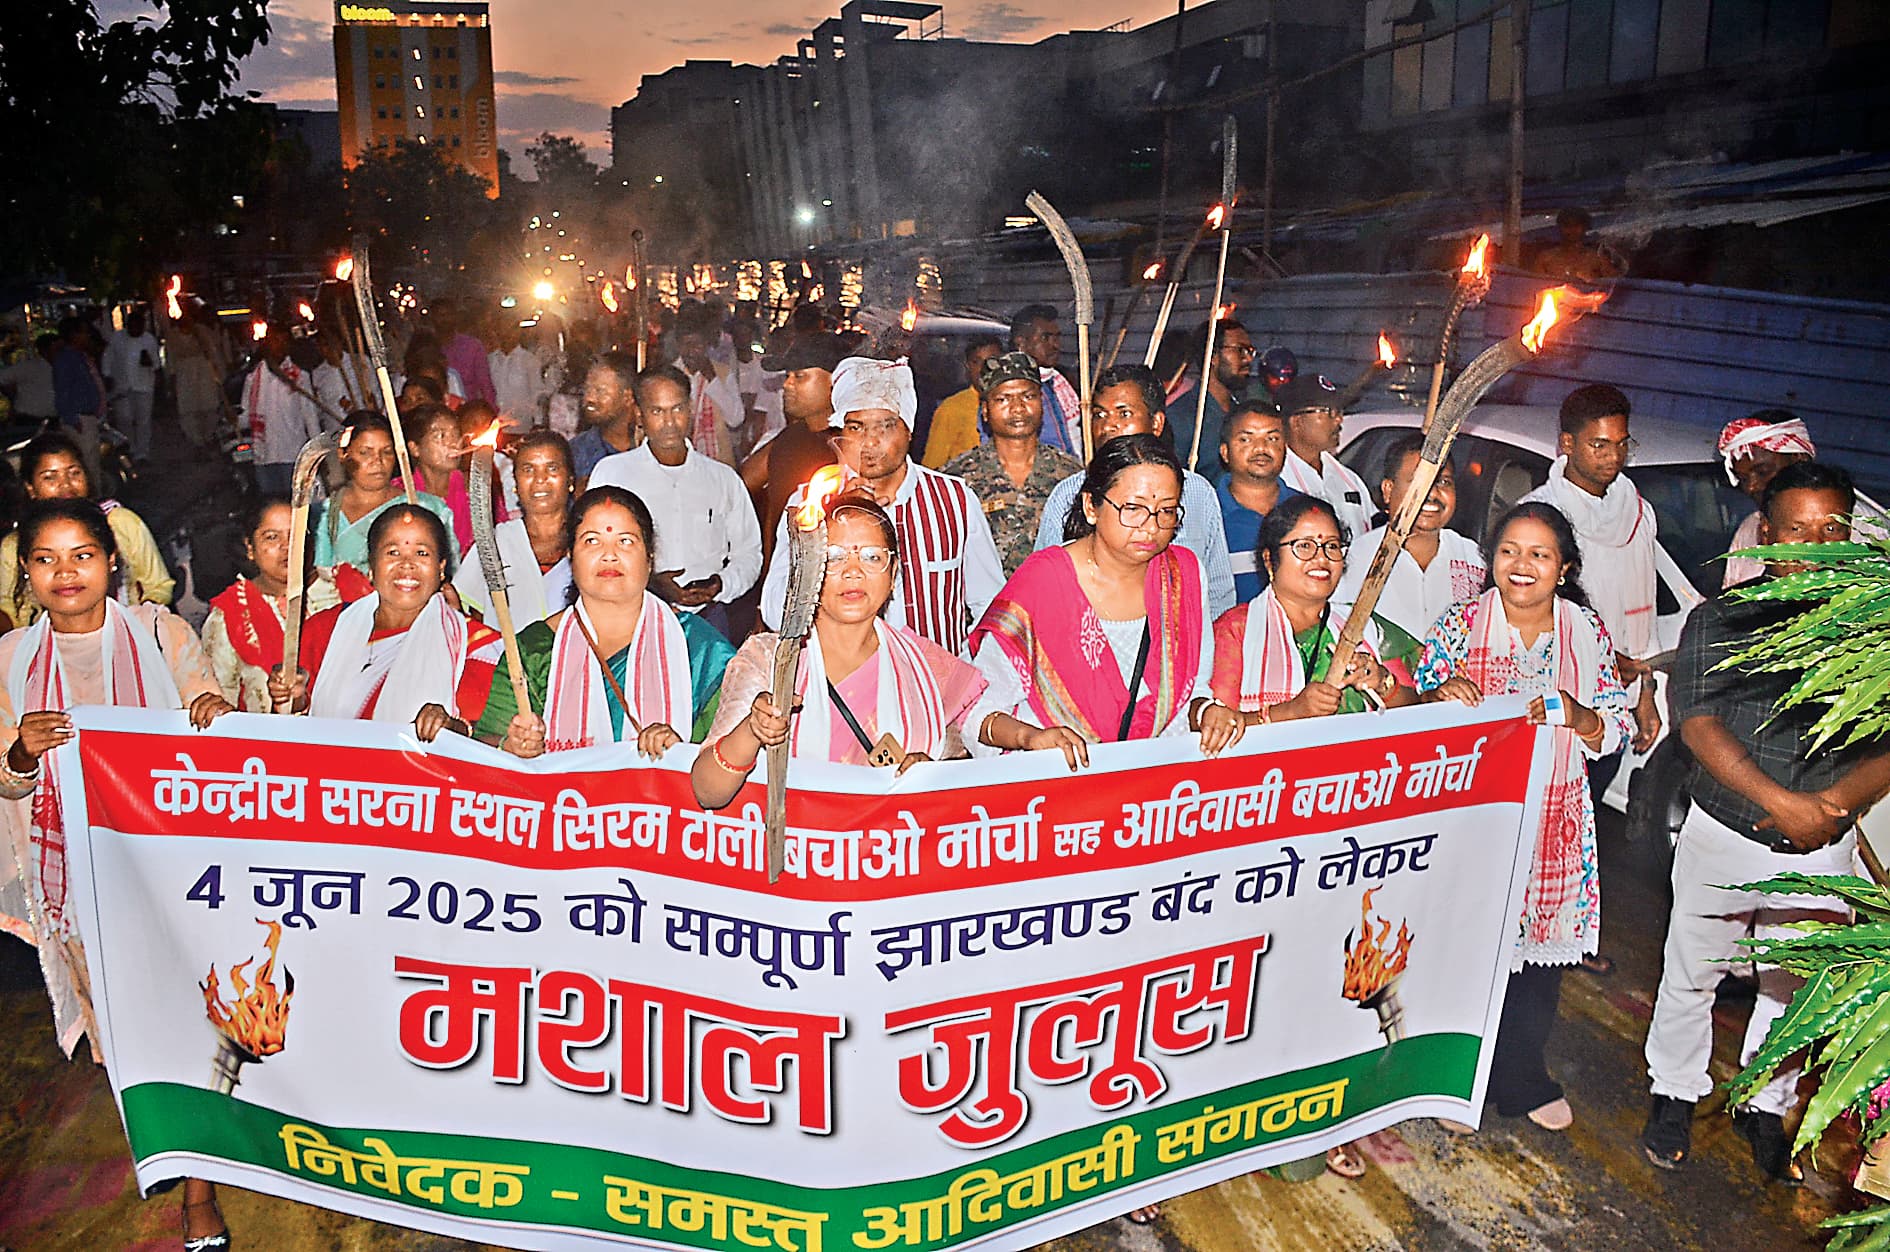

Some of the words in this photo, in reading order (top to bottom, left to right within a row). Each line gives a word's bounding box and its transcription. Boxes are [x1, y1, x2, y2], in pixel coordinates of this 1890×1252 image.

[341, 4, 392, 21] bloom
[150, 752, 309, 824] केन्द्रीय
[319, 778, 441, 834] सरना
[449, 787, 545, 849] स्थल
[551, 787, 672, 854] सिरम
[783, 810, 926, 881] बचाओ
[936, 796, 1046, 869] मोर्चा
[1053, 820, 1105, 858] सह
[1113, 768, 1287, 849] आदिवासी
[1292, 752, 1403, 818] बचाओ
[1404, 737, 1488, 799] मोर्चा
[186, 865, 226, 910] 4
[248, 866, 366, 930] जून
[387, 876, 542, 933] 2025
[564, 877, 648, 944] को
[663, 903, 853, 990] सम्पूर्ण
[870, 891, 1140, 982] झारखण्ड
[1151, 872, 1221, 922] बंद
[1235, 846, 1306, 904] को
[1318, 833, 1439, 890] लेकर
[392, 954, 846, 1136] मशाल
[884, 932, 1270, 1149] जुलूस
[278, 1123, 531, 1209] निवेदक
[552, 1190, 580, 1201] -
[603, 1175, 829, 1252] समस्त
[851, 1125, 1142, 1249] आदिवासी
[1156, 1077, 1350, 1163] संगठन
